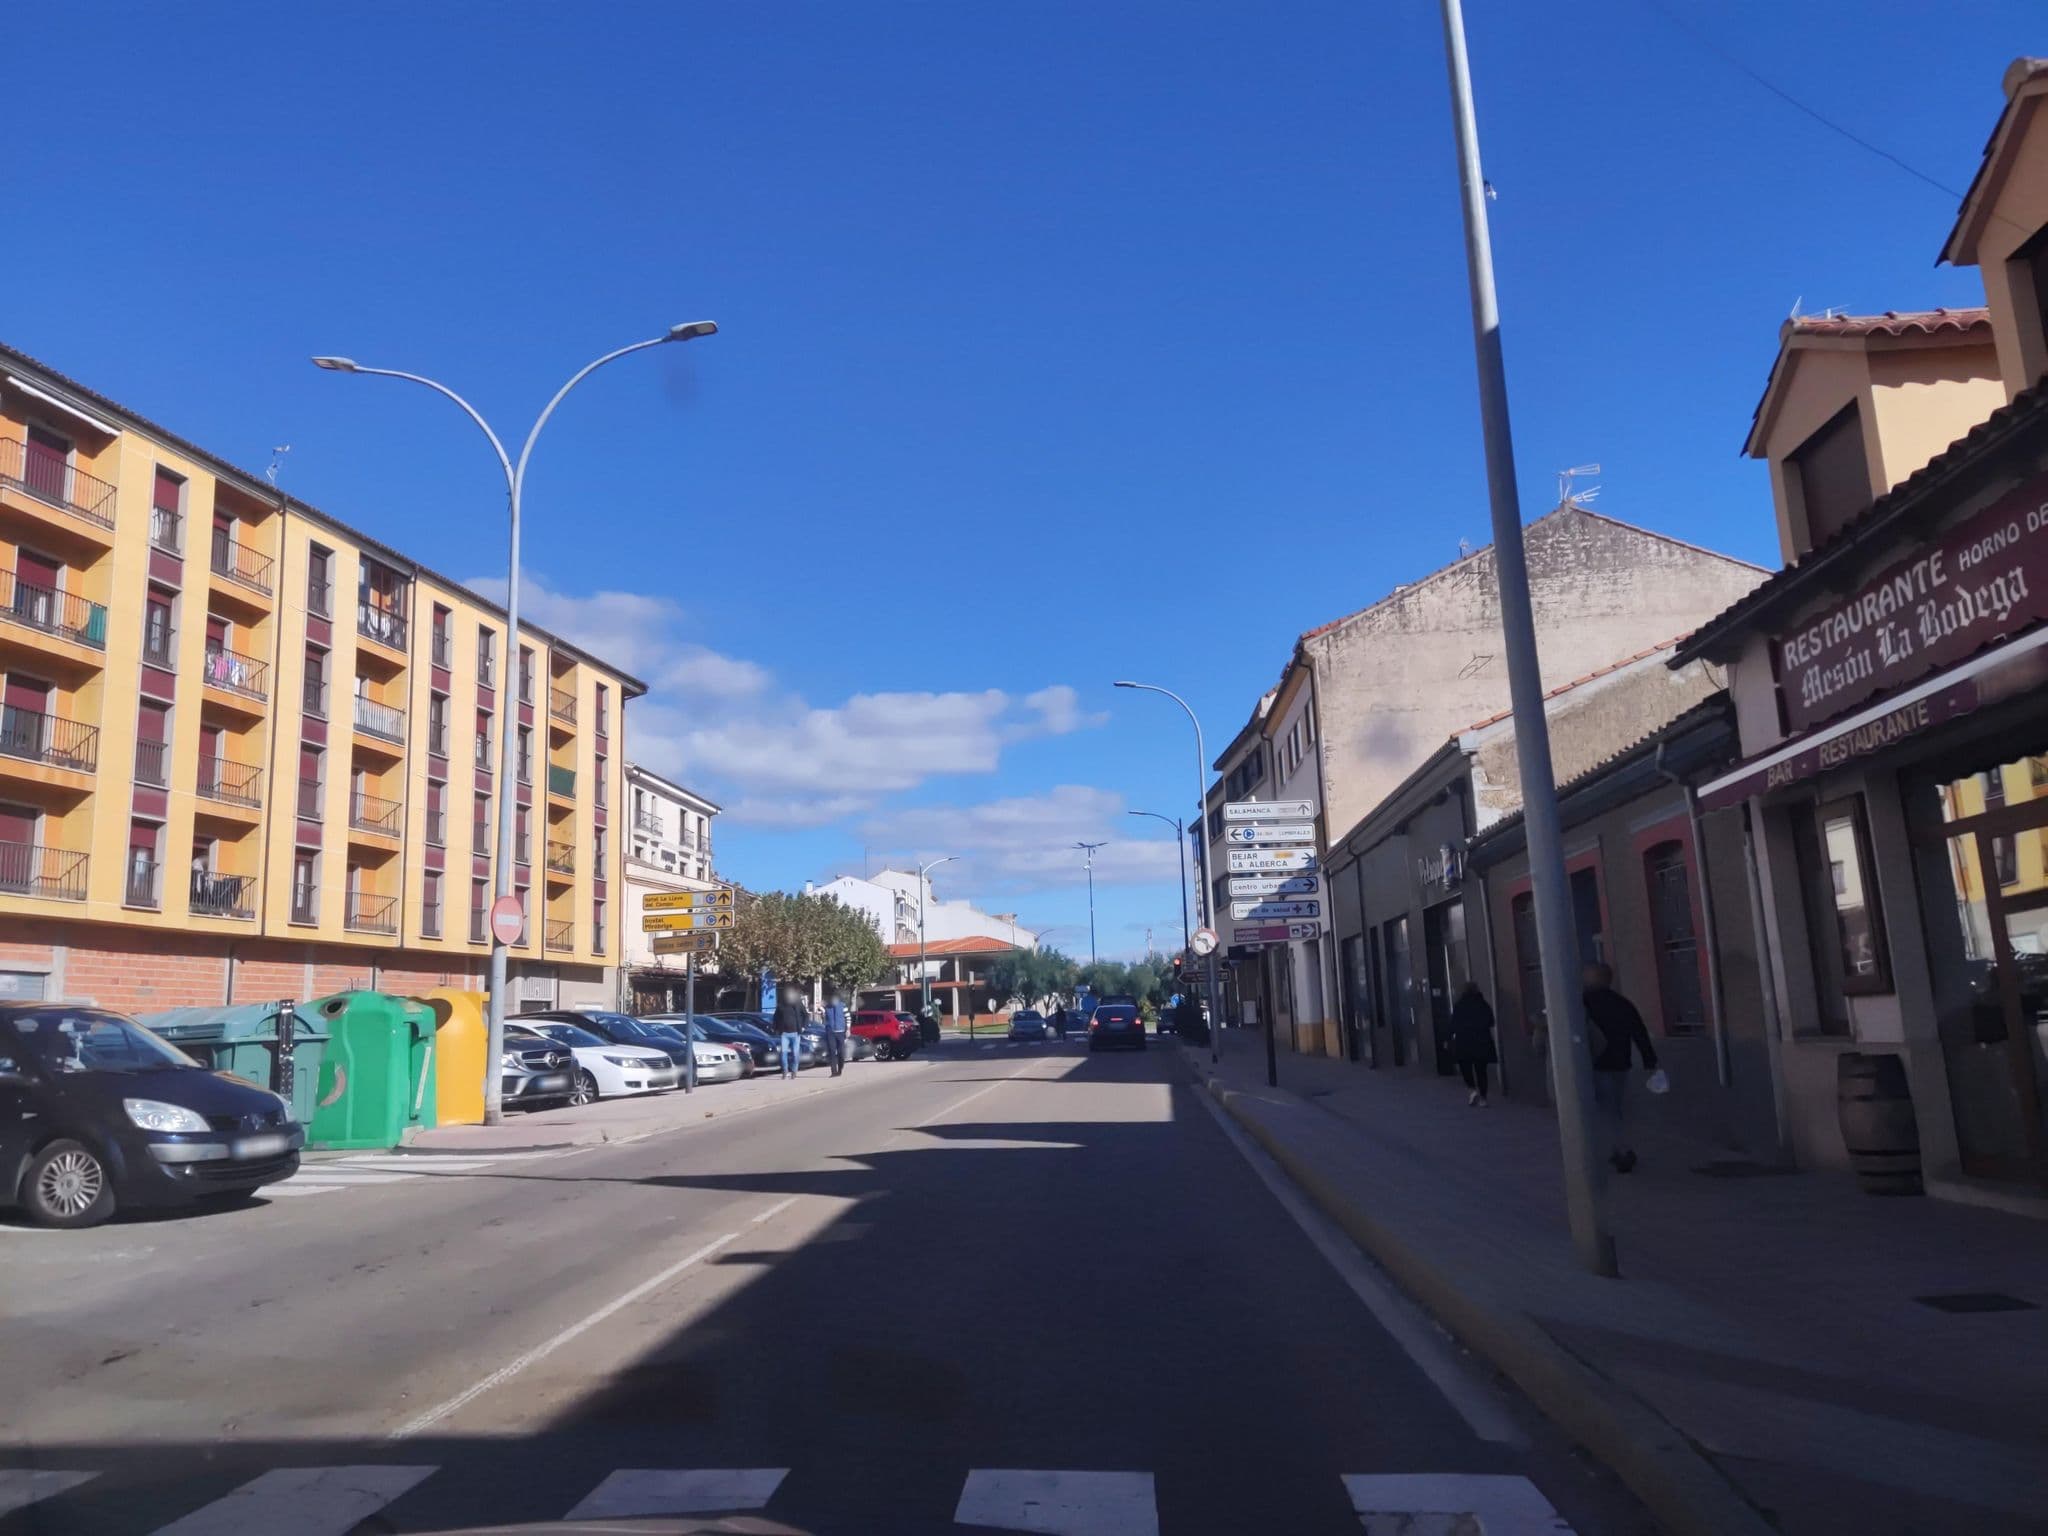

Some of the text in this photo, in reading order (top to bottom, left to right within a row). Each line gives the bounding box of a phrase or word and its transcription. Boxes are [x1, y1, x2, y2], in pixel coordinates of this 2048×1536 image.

[1783, 549, 1948, 671] RESTAURANTE
[1958, 523, 2020, 571] HORNO
[1801, 565, 2030, 708] Mesón La Bodega
[1766, 762, 1794, 789] BAR
[1818, 700, 1931, 766] RESTAURANTE
[1229, 807, 1272, 815] SALAMANCA
[1249, 860, 1289, 868] ALBERCA
